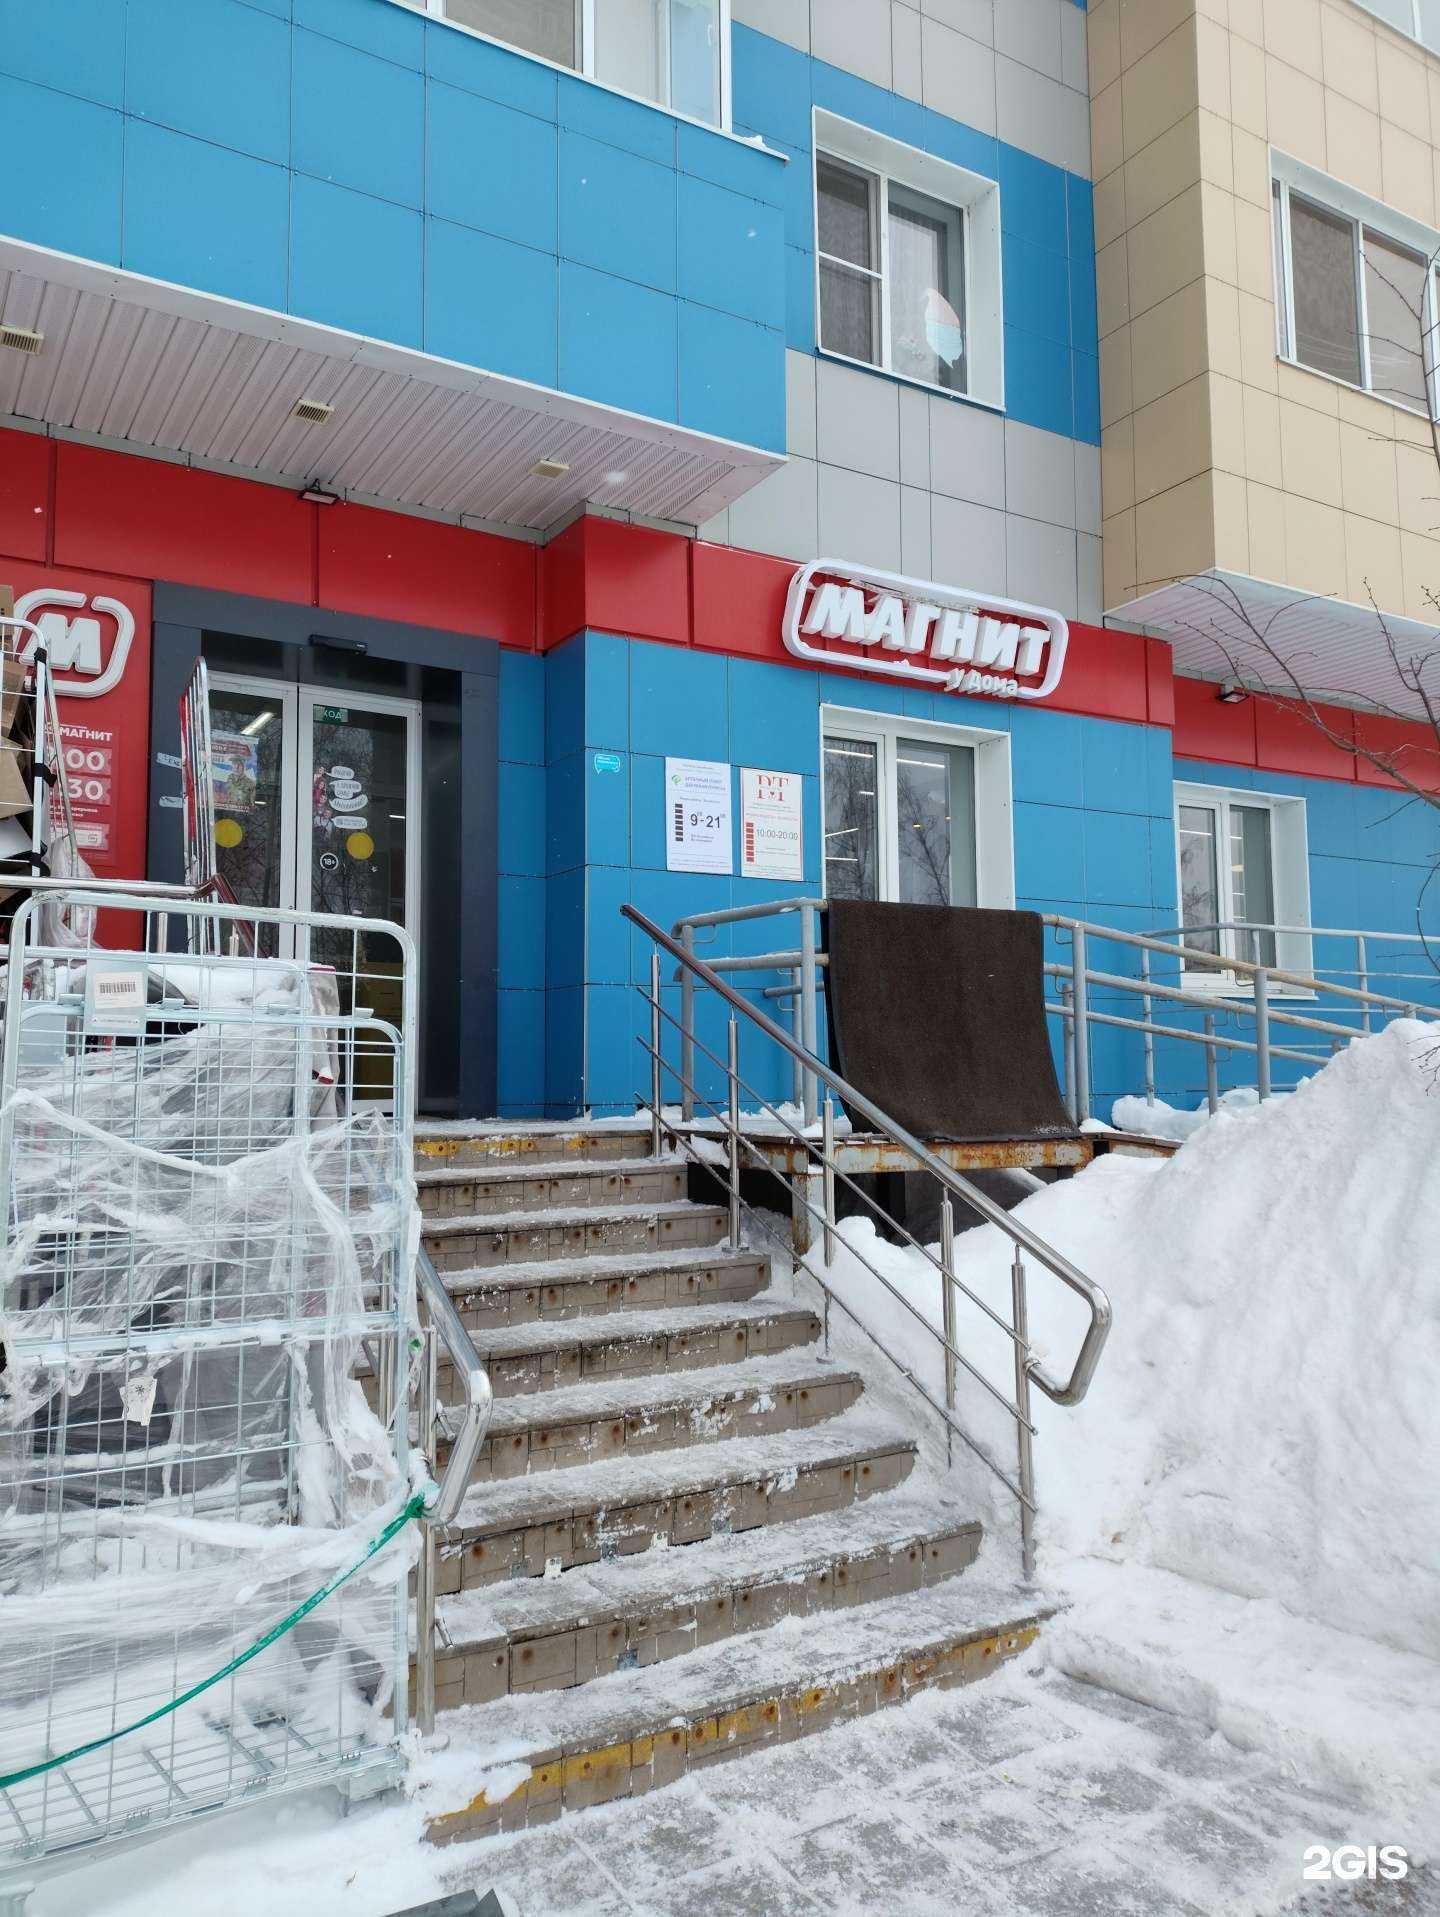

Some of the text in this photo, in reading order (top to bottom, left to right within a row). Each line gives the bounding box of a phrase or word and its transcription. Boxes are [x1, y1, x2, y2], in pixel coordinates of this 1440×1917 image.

[798, 582, 1051, 677] МАГНИТ
[19, 612, 101, 675] М
[944, 668, 966, 692] у
[59, 726, 113, 742] МАГНИТ
[323, 858, 336, 866] 18+
